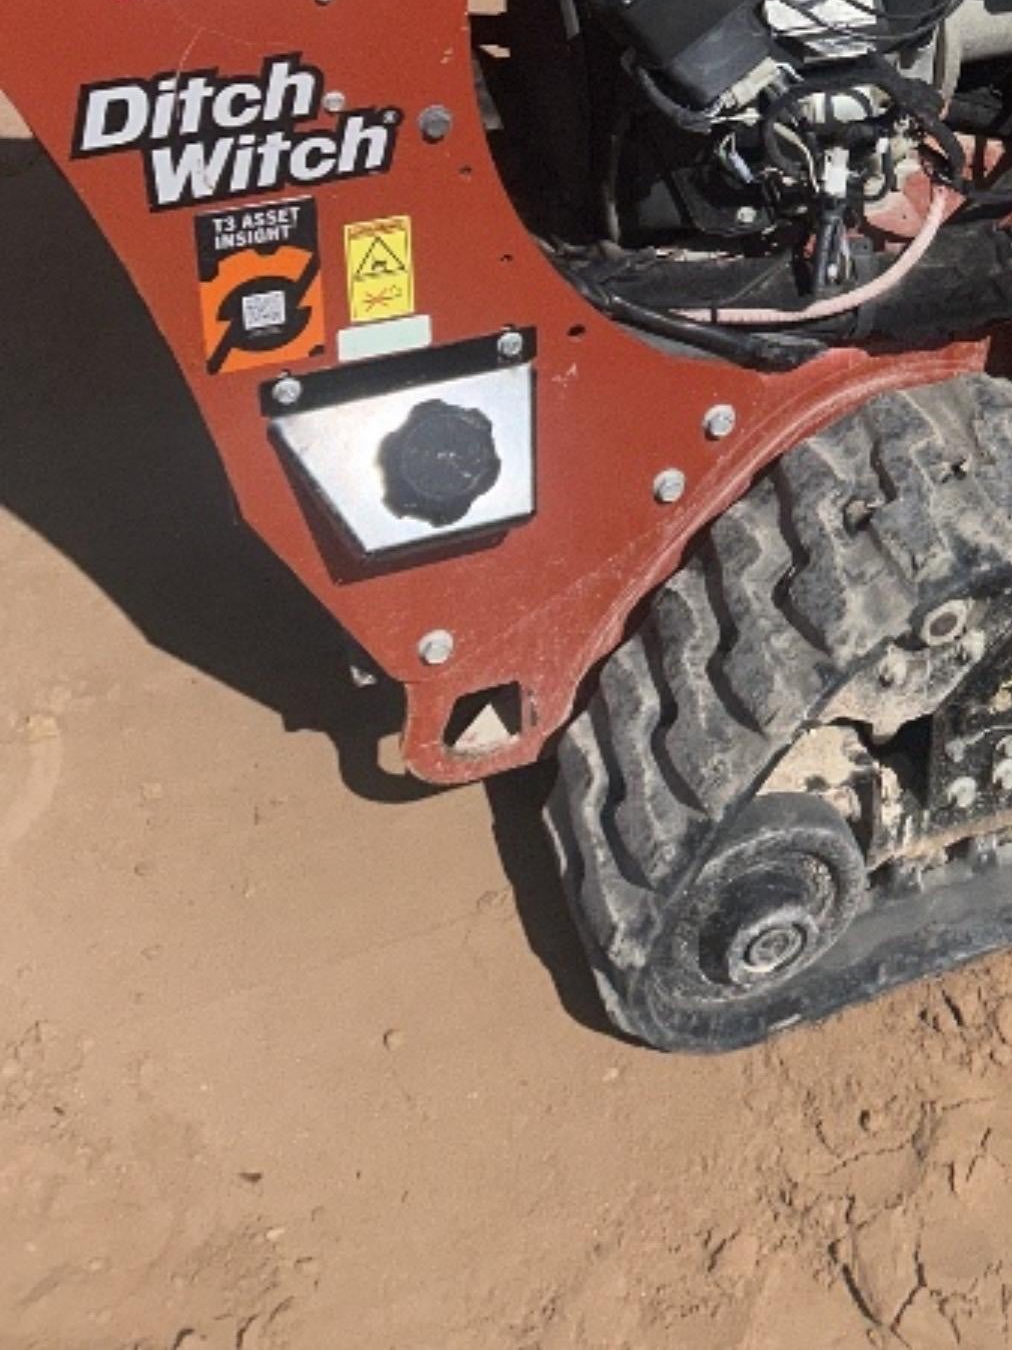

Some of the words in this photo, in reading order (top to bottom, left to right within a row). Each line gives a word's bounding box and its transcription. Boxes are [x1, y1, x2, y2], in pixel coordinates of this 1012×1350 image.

[80, 61, 316, 151] Ditch
[151, 115, 389, 205] Witch
[212, 215, 237, 233] T3
[241, 206, 300, 229] ASSET
[214, 224, 292, 250] INSIGHT
